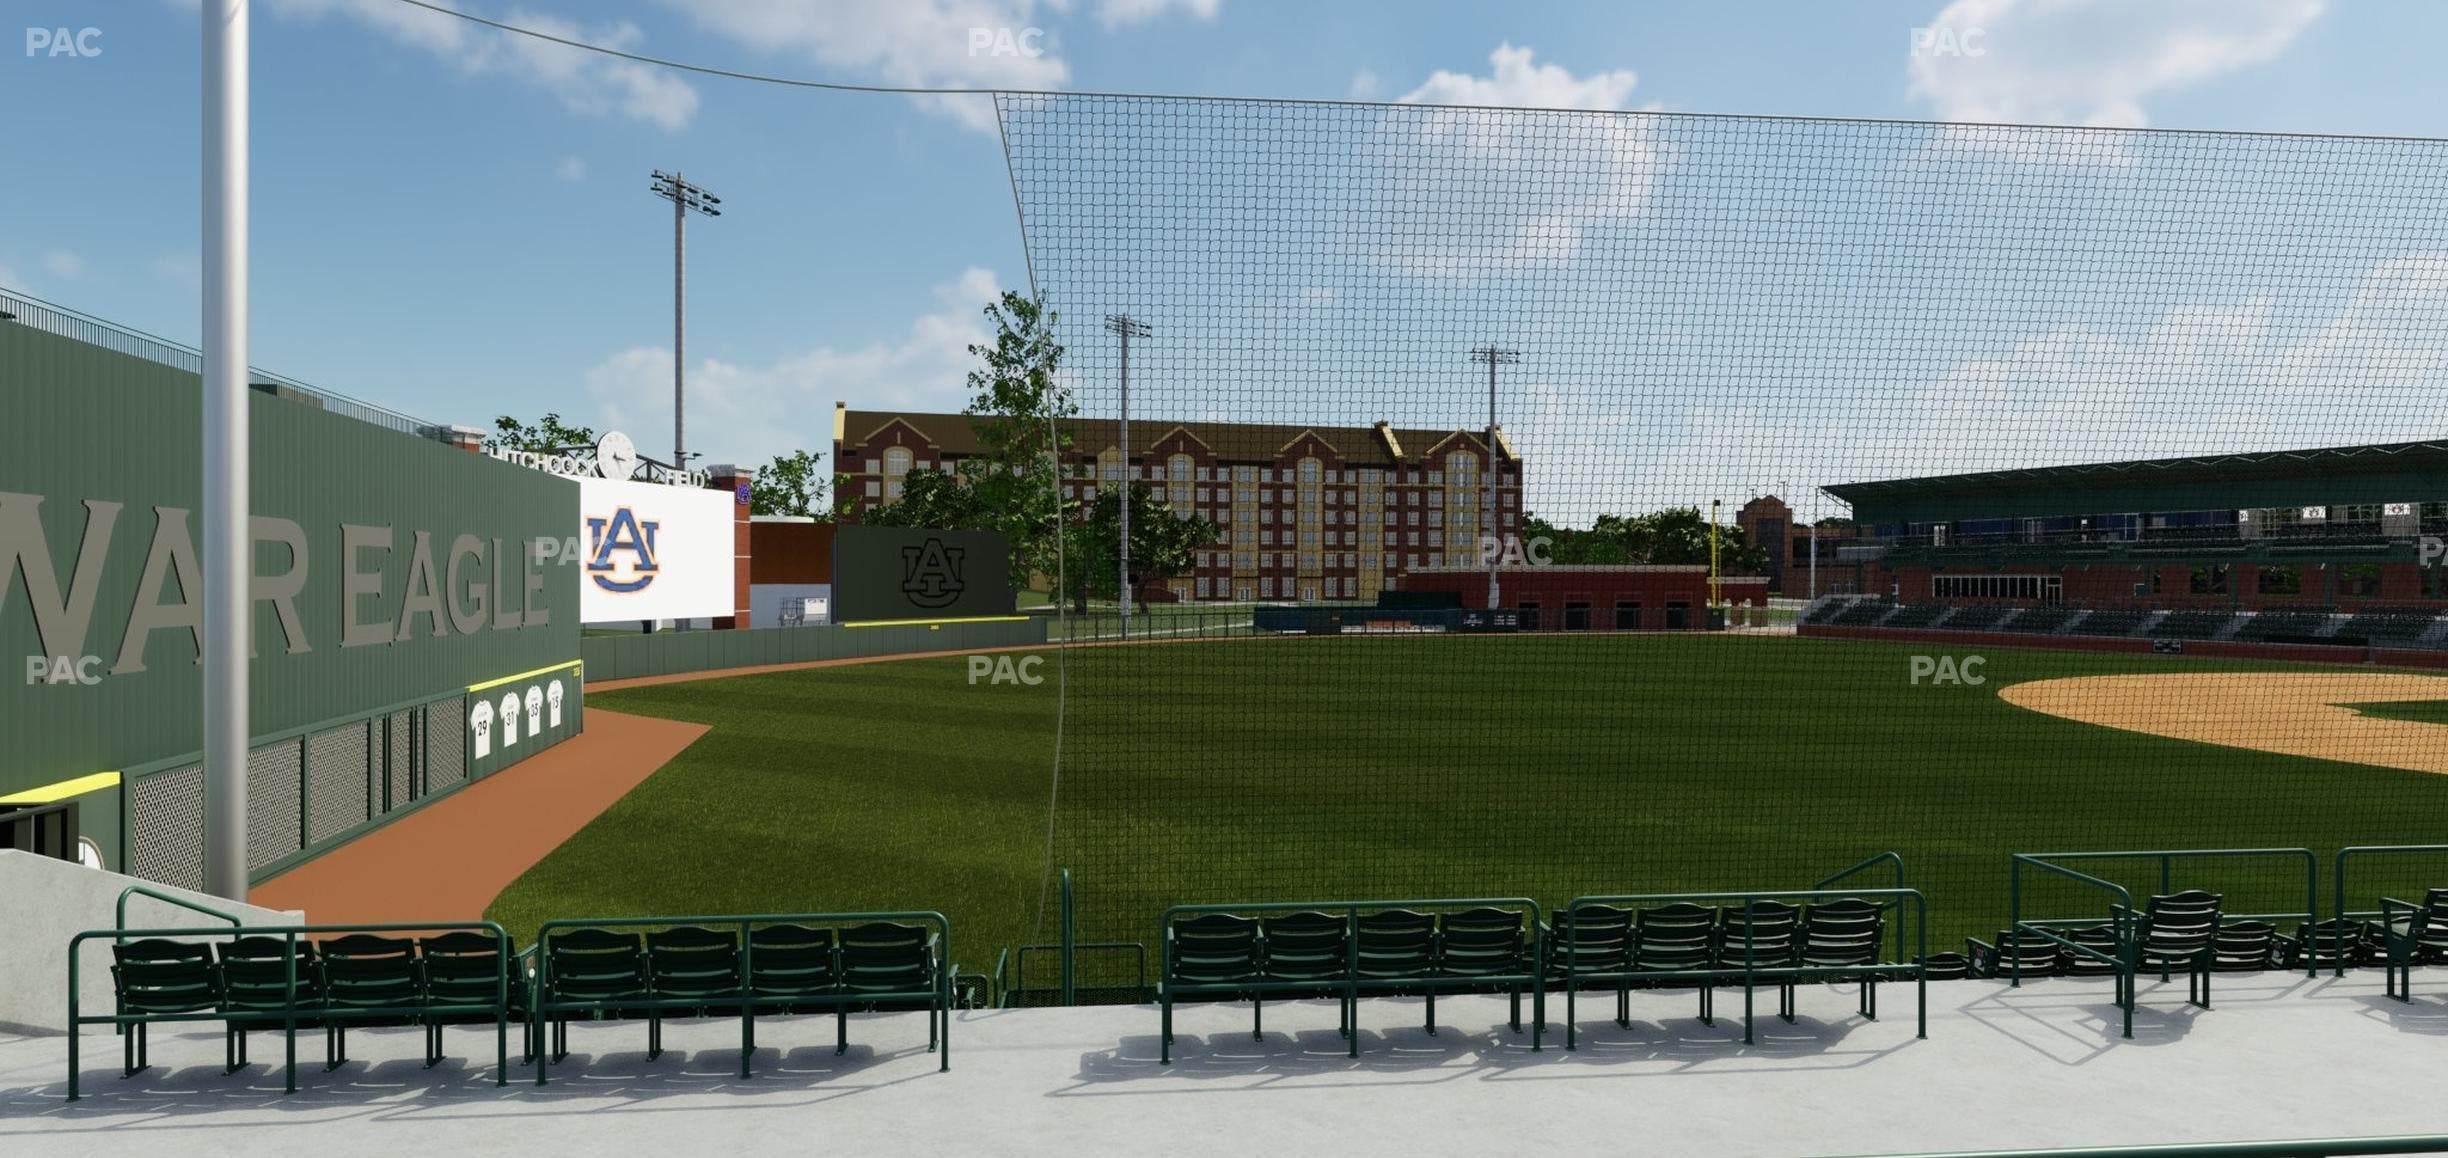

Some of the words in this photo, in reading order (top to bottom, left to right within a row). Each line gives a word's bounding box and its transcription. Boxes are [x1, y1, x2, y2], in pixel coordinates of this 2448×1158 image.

[664, 468, 705, 488] FIELD
[339, 522, 549, 648] EAGLE
[506, 711, 515, 726] 31
[477, 720, 488, 736] 29
